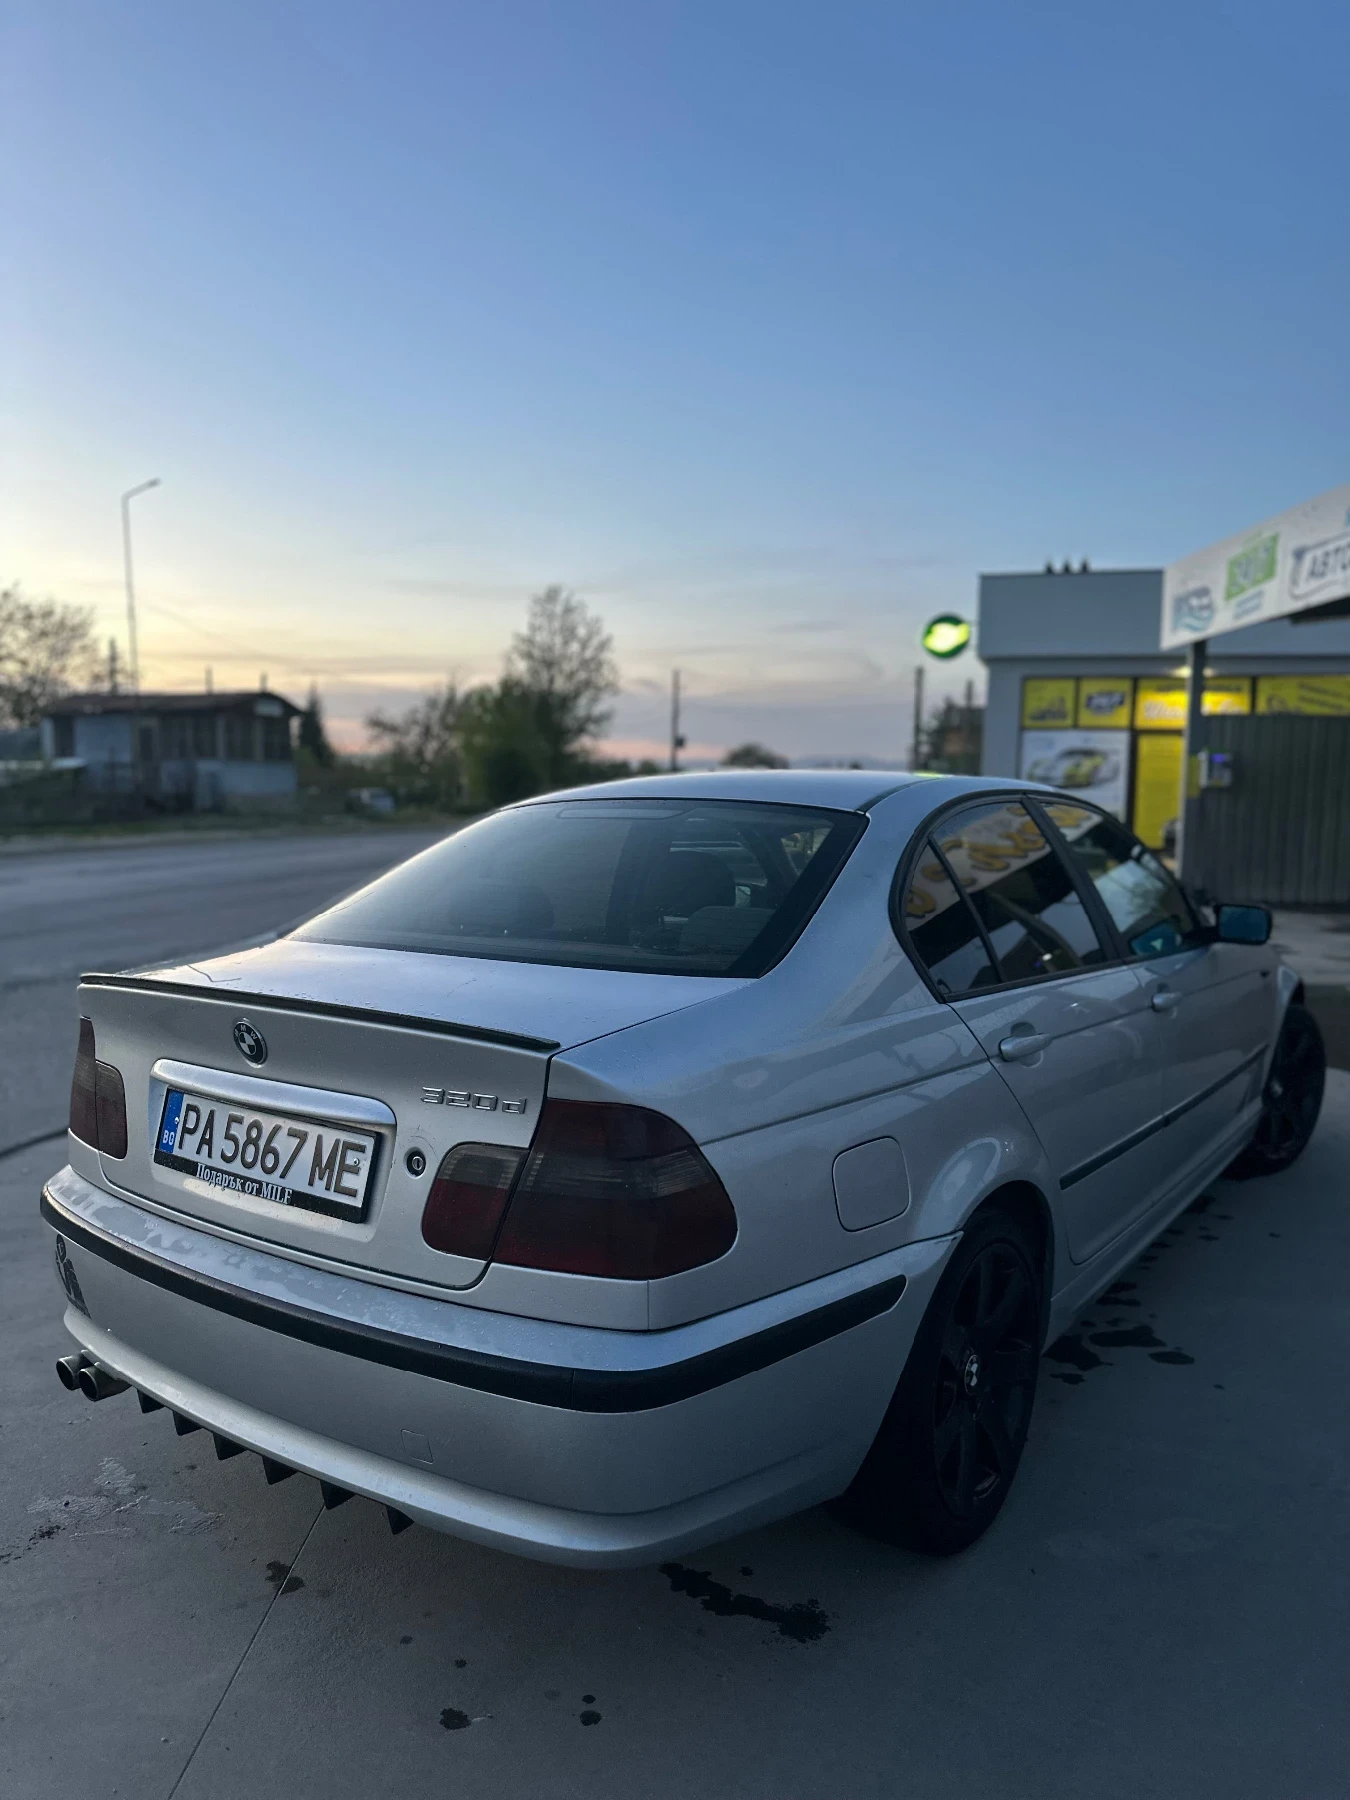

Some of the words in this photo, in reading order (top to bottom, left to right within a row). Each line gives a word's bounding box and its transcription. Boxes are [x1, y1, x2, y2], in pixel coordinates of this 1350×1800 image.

[420, 1086, 527, 1115] 320d
[162, 1129, 176, 1146] BG
[178, 1103, 216, 1158] PA
[220, 1112, 309, 1180] 5867
[307, 1133, 368, 1198] ME
[195, 1162, 244, 1192] Подарък
[244, 1182, 260, 1196] от
[260, 1181, 293, 1205] MILF
